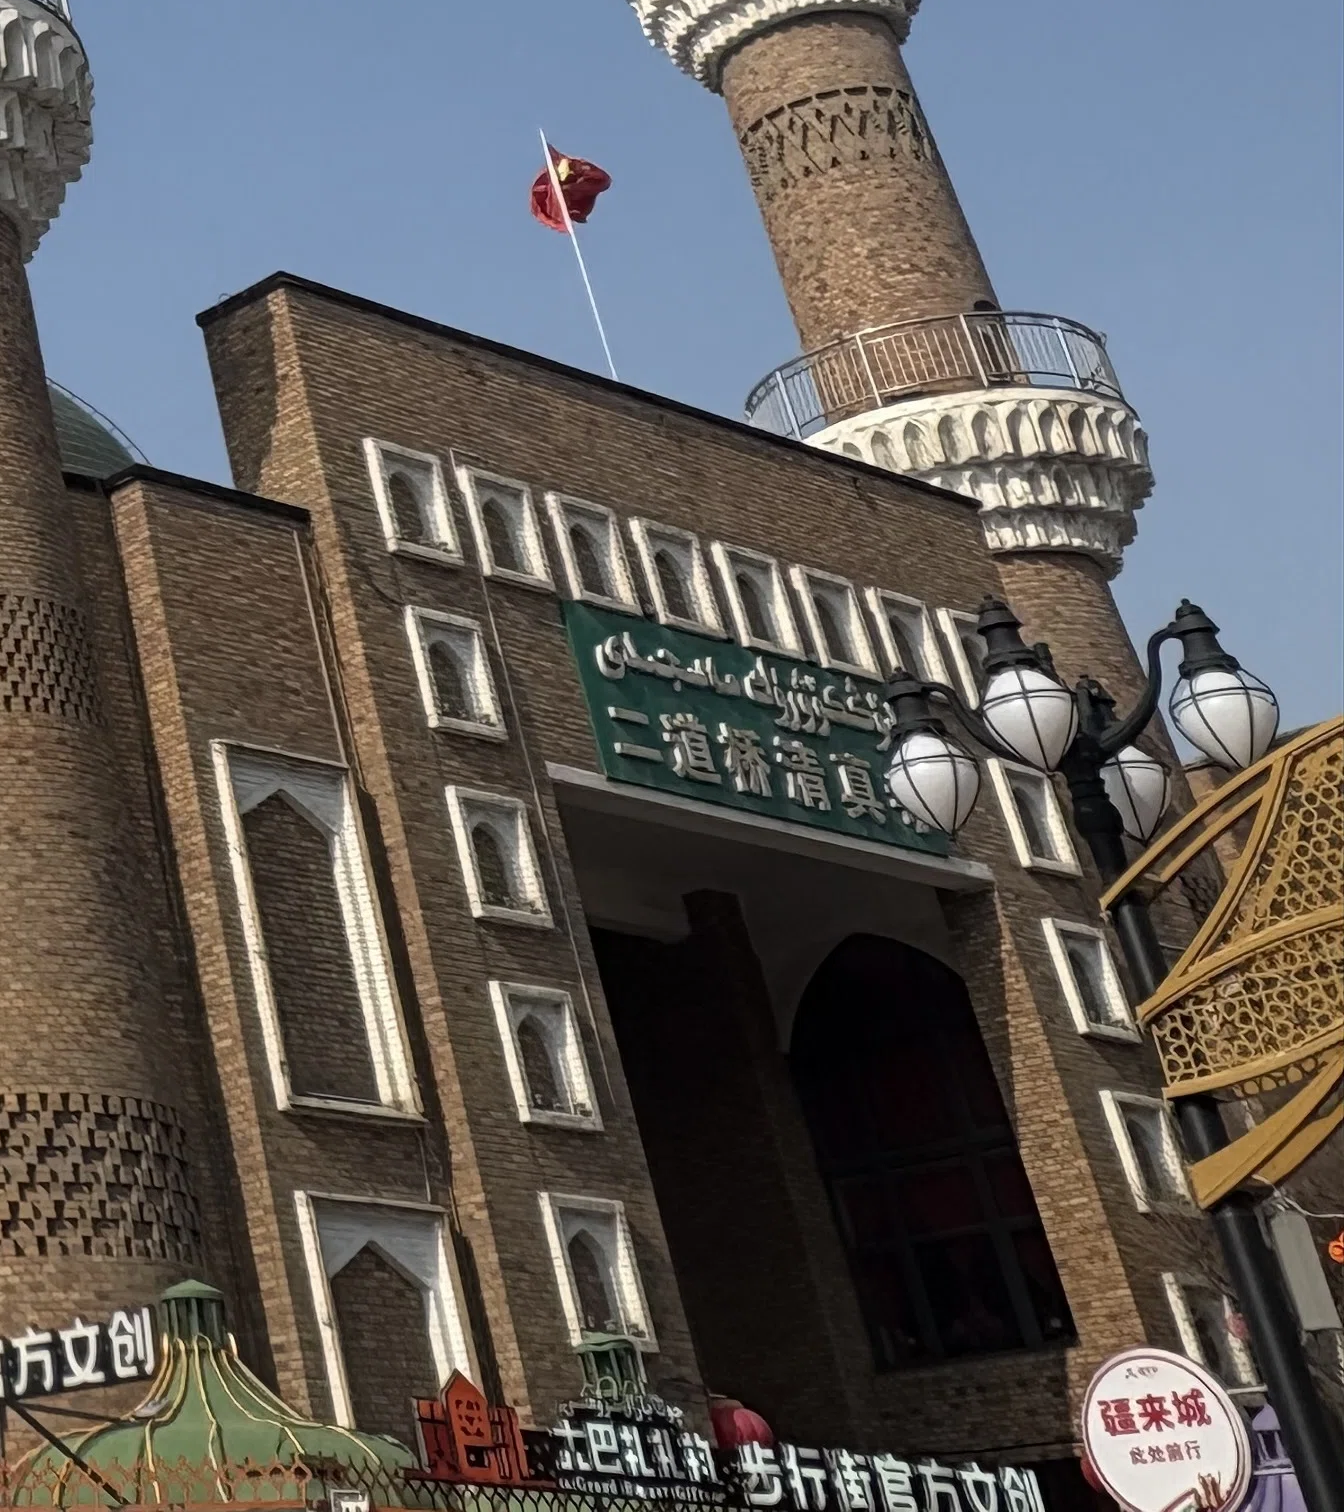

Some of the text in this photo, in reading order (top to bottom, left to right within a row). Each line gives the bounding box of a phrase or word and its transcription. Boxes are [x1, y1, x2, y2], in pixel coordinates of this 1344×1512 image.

[607, 705, 932, 834] 二道桥清真
[738, 1441, 1046, 1512] 步行街官方文创
